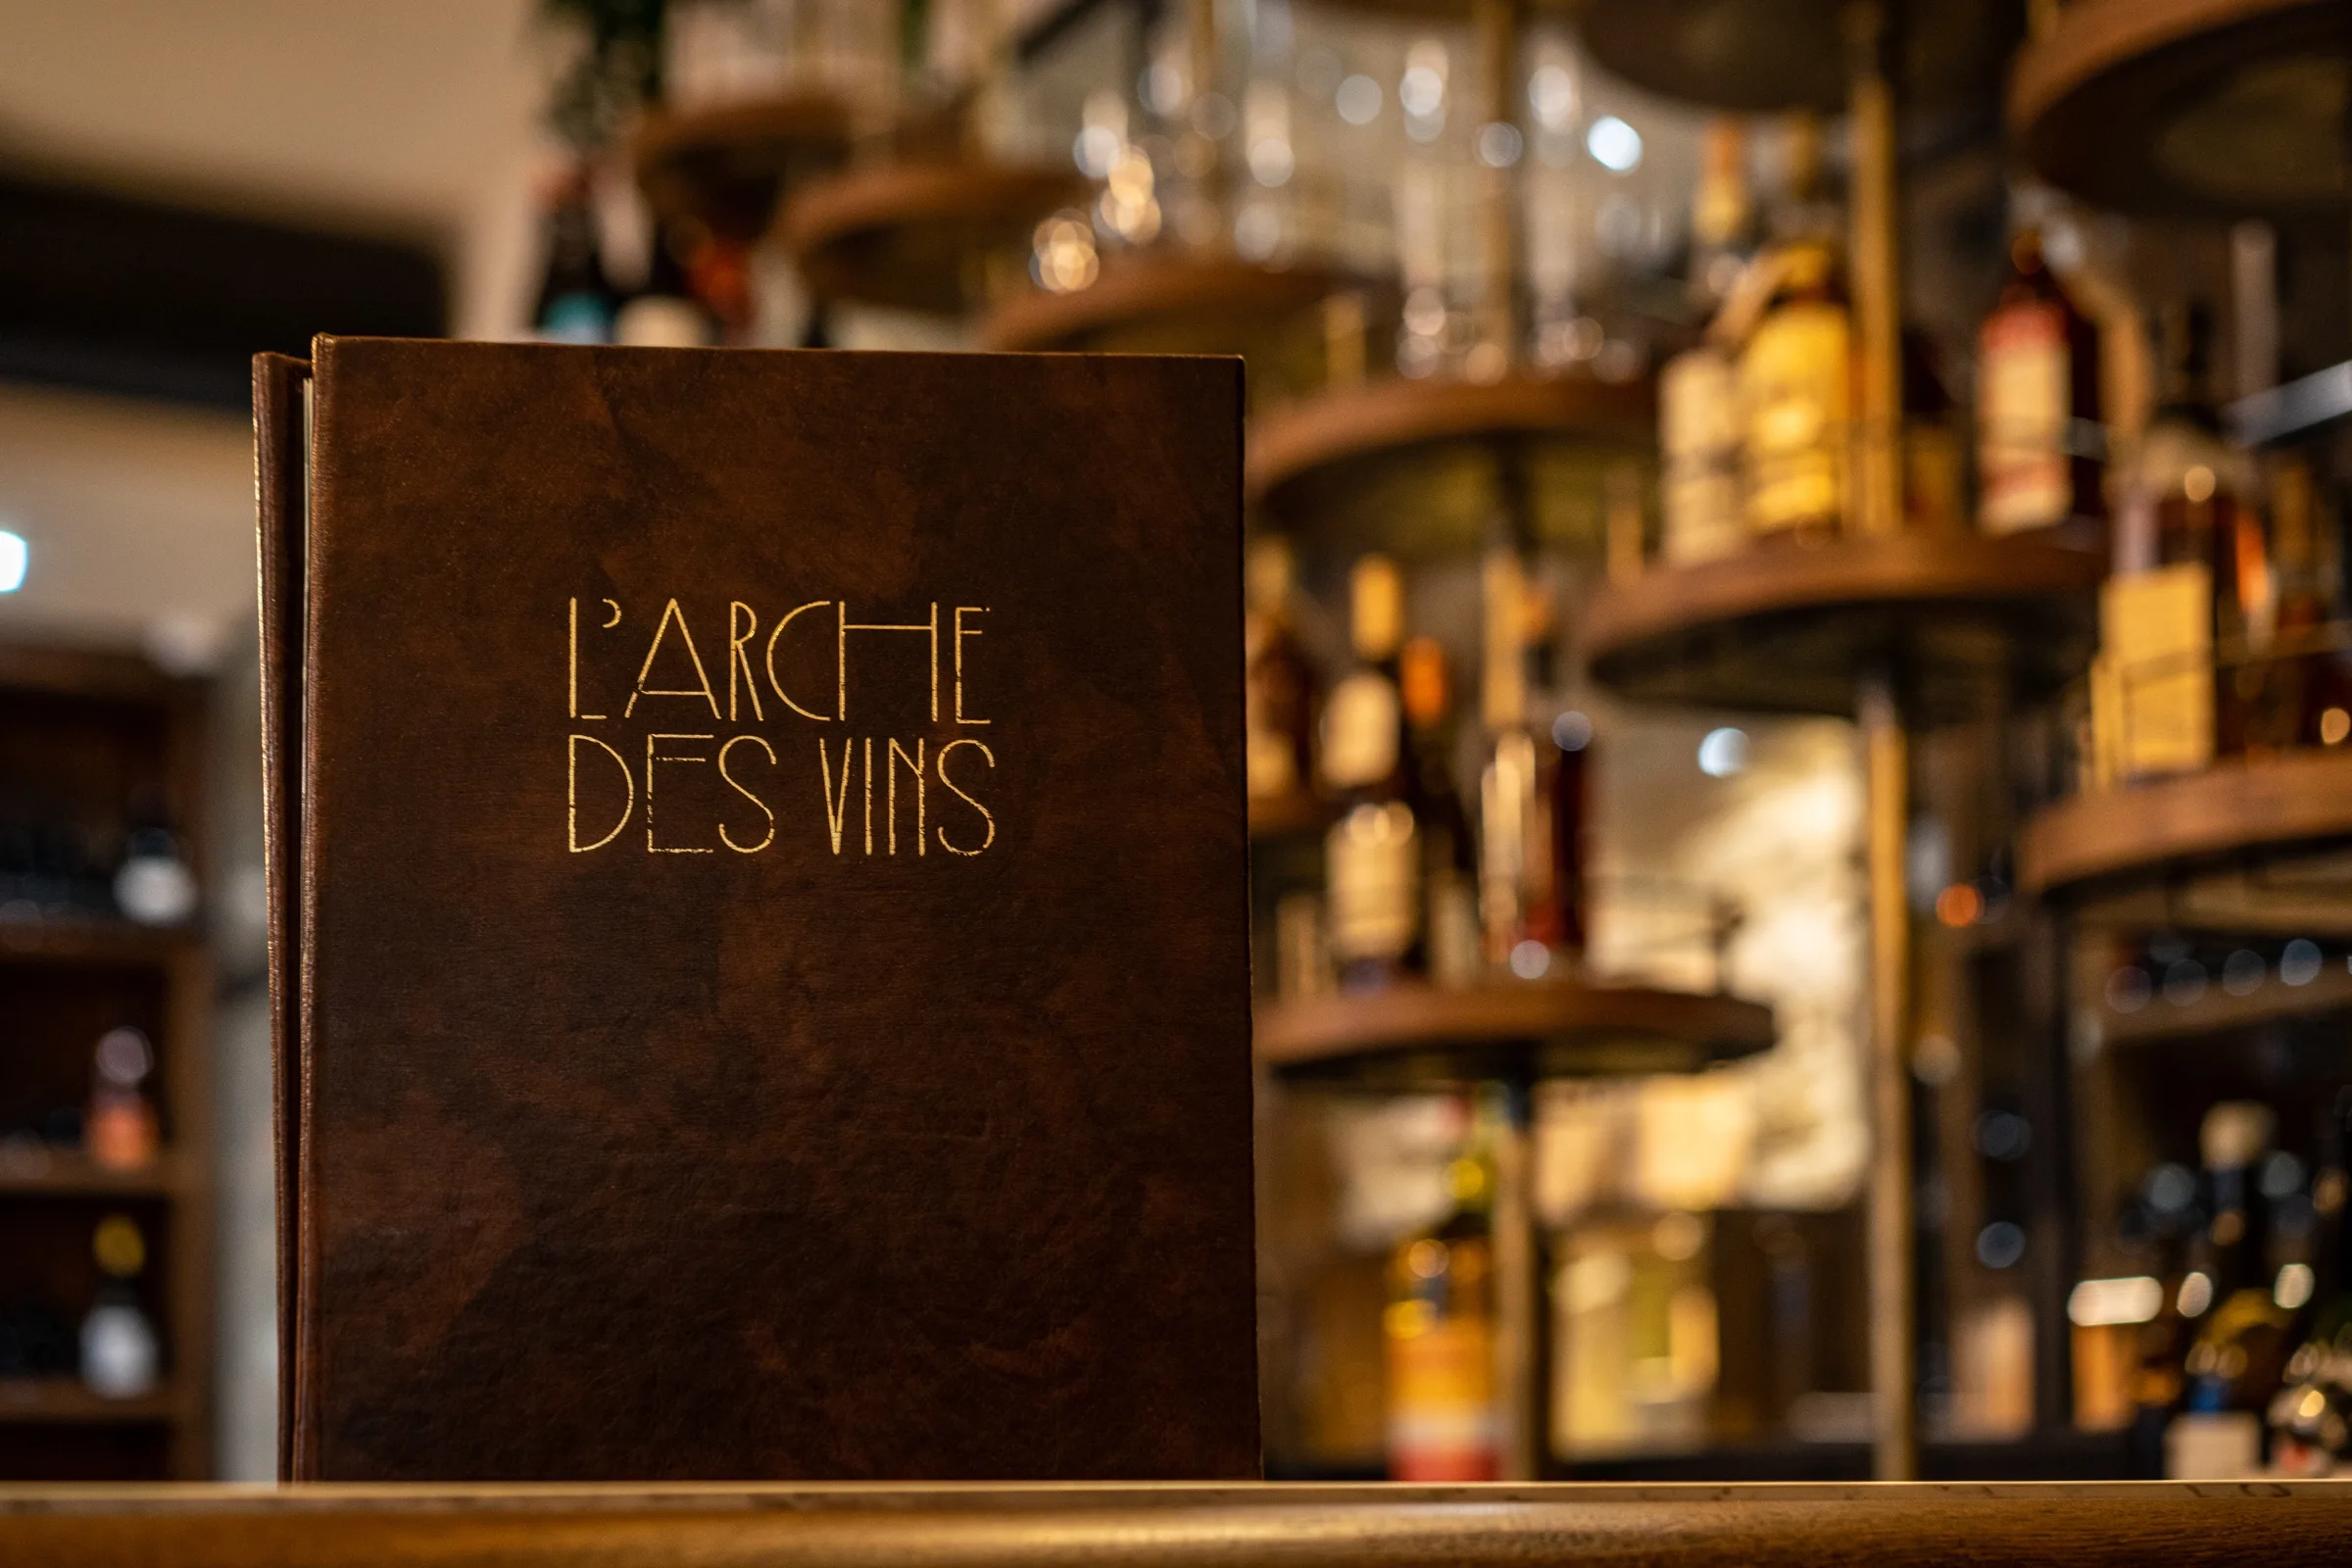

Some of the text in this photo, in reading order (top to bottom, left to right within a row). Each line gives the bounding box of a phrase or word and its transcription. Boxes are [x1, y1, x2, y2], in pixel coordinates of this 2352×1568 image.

[569, 596, 992, 724] L'ARCHE
[567, 733, 996, 857] DES VINS
